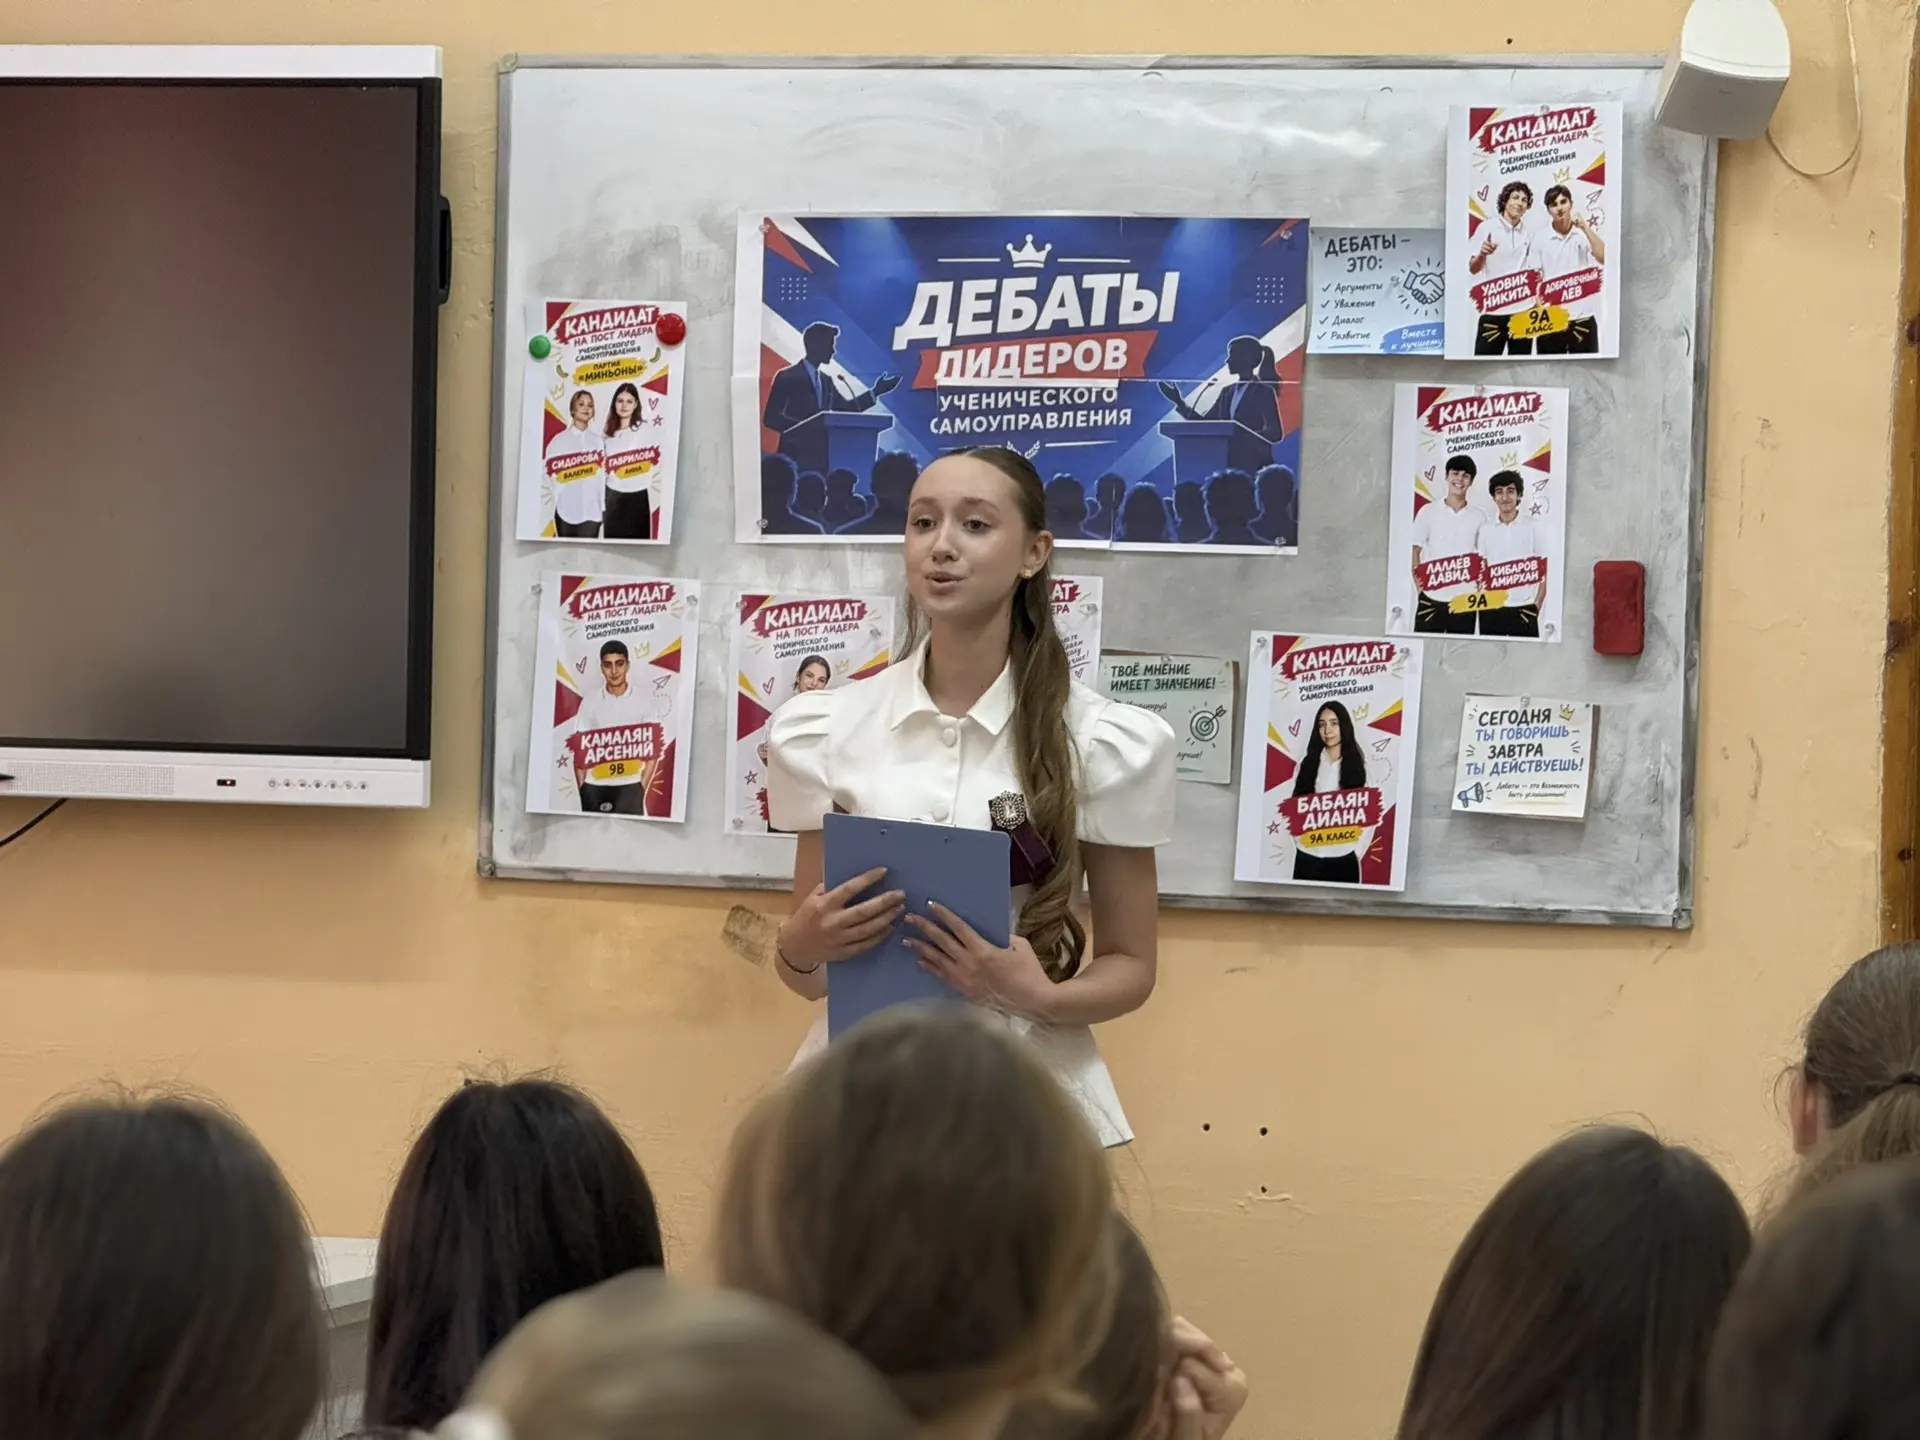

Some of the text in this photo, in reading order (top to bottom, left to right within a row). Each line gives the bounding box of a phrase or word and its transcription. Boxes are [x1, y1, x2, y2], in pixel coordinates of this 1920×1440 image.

[1491, 109, 1591, 146] КАНДИДАТ
[1501, 130, 1589, 155] НА ПОСТ ЛИДЕРА
[1498, 148, 1559, 166] УЧЕНИЧЕСКОГО
[1500, 152, 1576, 174] САМОУПРАВЛЕНИЯ
[1325, 234, 1396, 258] ДЕБАТЫ
[1347, 256, 1382, 272] ЭТО:
[1334, 282, 1383, 296] Аргументы
[1482, 272, 1528, 296] УДОВИК
[1484, 286, 1530, 308] НИКИТА
[1561, 285, 1582, 302] ЛЕВ
[892, 271, 1180, 350] ДЕБАТЫ
[1334, 299, 1375, 308] Уважение
[565, 307, 655, 337] КАНДИДАТ
[1332, 316, 1364, 326] Диалог
[1529, 309, 1550, 325] 9А
[574, 326, 653, 347] НА ПОСТ ЛИДЕРА
[1331, 331, 1370, 340] Развитие
[1401, 329, 1436, 339] Вместе
[1525, 323, 1553, 335] КЛАСС
[576, 347, 641, 362] САМОУПРАВЛЕНИЯ
[579, 340, 635, 355] УЧЕНИЧЕСКОГО
[593, 360, 620, 370] ПАРТИЯ
[934, 338, 1128, 380] ЛИДЕРОВ
[579, 364, 643, 381] «МИНЬОНЫ»
[940, 387, 1117, 412] УЧЕНИЧЕСКОГО
[1438, 394, 1537, 425] КАНДИДАТ
[1448, 414, 1534, 434] НА ПОСТ ЛИДЕРА
[1446, 430, 1504, 445] УЧЕНИЧЕСКОГО
[1447, 435, 1521, 453] САМОУПРАВЛЕНИЯ
[552, 453, 598, 469] СИДОРОВА
[608, 450, 655, 467] ГАВРИЛОВА
[1426, 557, 1471, 574] ЛАЛАЕВ
[1490, 560, 1538, 578] КИБАРОВ
[1428, 570, 1470, 587] ДАВИД
[1491, 571, 1538, 589] АМИРХАН
[579, 585, 670, 612] КАНДИДАТ
[1468, 595, 1488, 608] 9А
[588, 604, 667, 621] НА ПОСТ ЛИДЕРА
[765, 602, 862, 630] КАНДИДАТ
[585, 618, 638, 632] УЧЕНИЧЕСКОГО
[586, 624, 654, 640] САМОУПРАВЛЕНИЯ
[776, 622, 860, 640] НА ПОСТ ЛИДЕРА
[773, 637, 828, 650] УЧЕНИЧЕСКОГО
[775, 642, 845, 659] САМОУПРАВЛЕНИЯ
[1293, 645, 1389, 673] КАНДИДАТ
[1111, 663, 1191, 678] ТВОЁ МНЕНИЕ
[1302, 664, 1387, 683] НА ПОСТ ЛИДЕРА
[1111, 678, 1216, 691] ИМЕЕТ ЗНАЧЕНИЕ!
[1299, 679, 1357, 694] УЧЕНИЧЕСКОГО
[1300, 685, 1373, 701] САМОУПРАВЛЕНИЯ
[1478, 708, 1551, 726] СЕГОДНЯ
[581, 726, 652, 750] КАМАЛЯН
[1476, 729, 1495, 742] ТЫ
[1500, 725, 1569, 740] ГОВОРИШЬ
[584, 741, 654, 764] АРСЕНИЙ
[1488, 744, 1543, 759] ЗАВТРА
[609, 764, 624, 775] 9В
[1466, 758, 1584, 776] ТЫ ДЕЙСТВУЕШЬ!
[1297, 791, 1369, 814] БАБАЯН
[1302, 808, 1366, 831] ДИАНА
[1310, 831, 1355, 844] 9А КЛАСС
